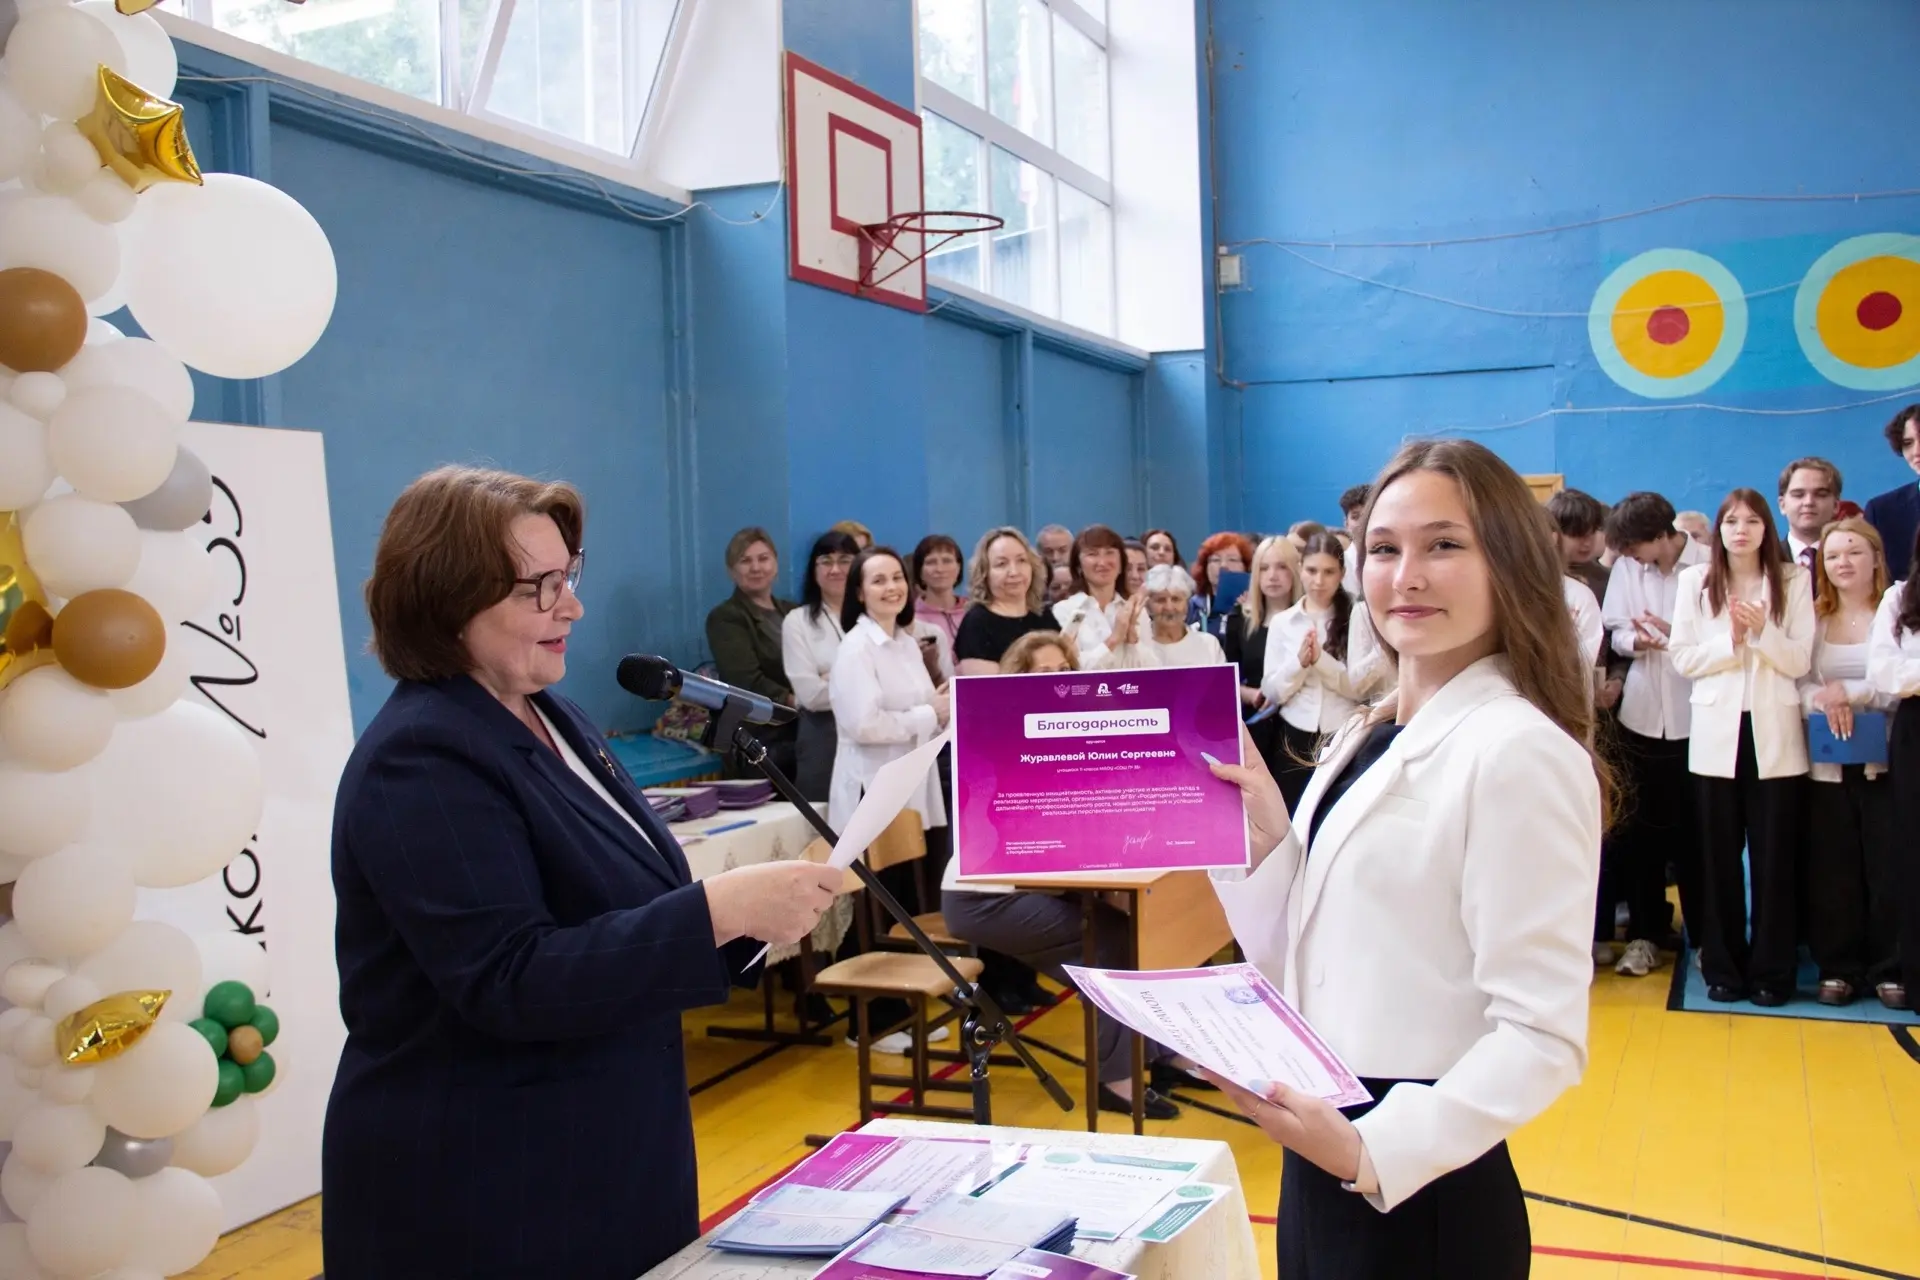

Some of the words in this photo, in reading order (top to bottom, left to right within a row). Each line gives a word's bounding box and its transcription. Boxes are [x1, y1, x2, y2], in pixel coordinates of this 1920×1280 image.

[1037, 715, 1158, 732] Благодарность
[1020, 750, 1085, 764] Журавлевой
[1087, 750, 1117, 760] Юлии
[1120, 747, 1175, 760] Сергеевне
[1005, 790, 1044, 798] проявленную
[1045, 788, 1093, 797] инициативность,
[1034, 802, 1093, 810] профессионального
[1041, 808, 1076, 816] реализации
[1077, 807, 1122, 815] перспективных
